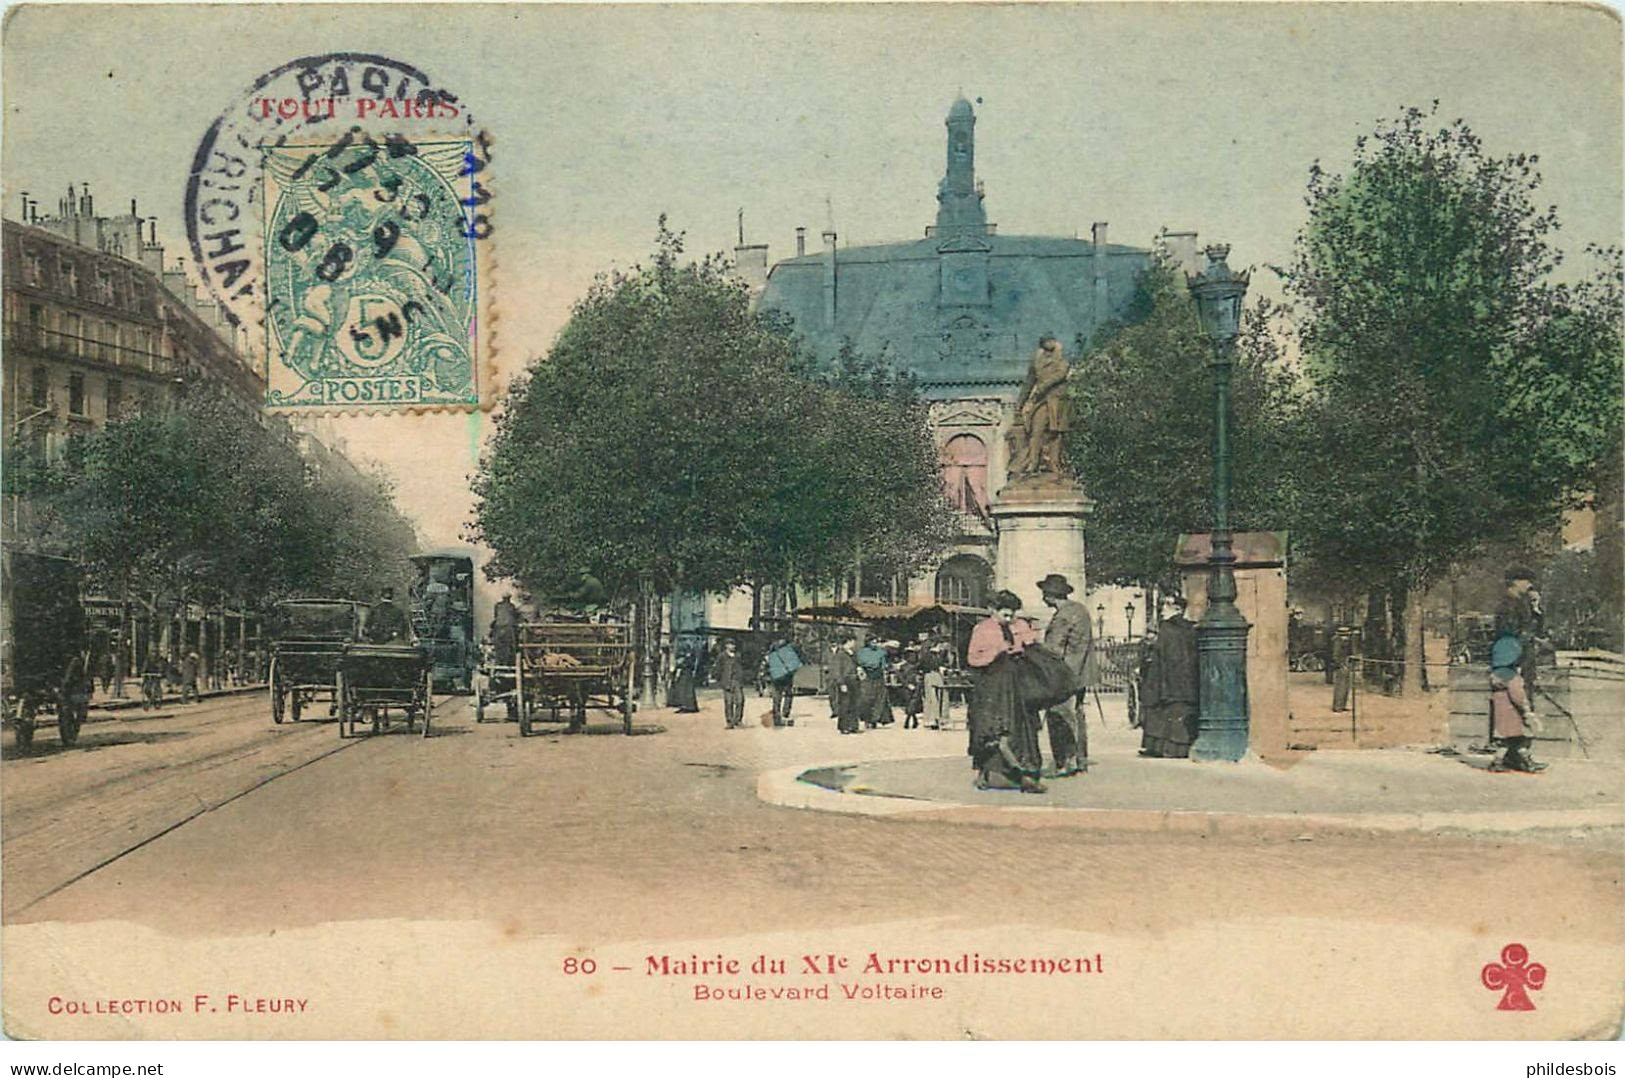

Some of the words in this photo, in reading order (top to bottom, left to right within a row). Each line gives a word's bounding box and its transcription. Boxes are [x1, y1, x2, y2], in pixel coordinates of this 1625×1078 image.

[254, 98, 336, 119] TOUT
[357, 98, 460, 119] PARIS
[328, 378, 417, 401] POSTES
[563, 958, 598, 975] 80
[646, 954, 741, 976] Mairie
[751, 954, 786, 976] du
[864, 953, 1105, 978] Arrondissement
[694, 982, 830, 1001] Boulevard
[841, 981, 945, 1001] Voltaire
[194, 994, 217, 1013] F.
